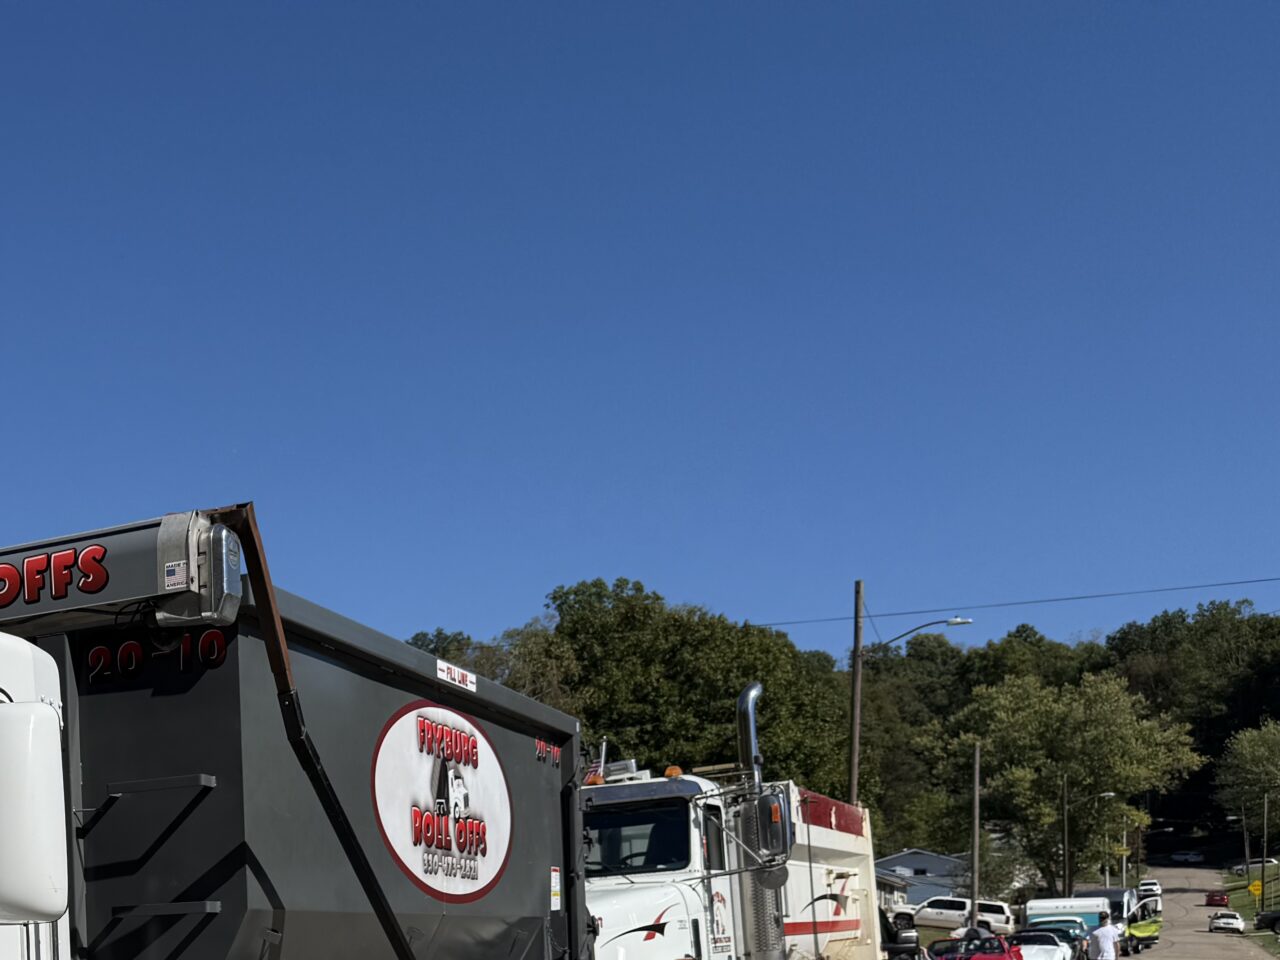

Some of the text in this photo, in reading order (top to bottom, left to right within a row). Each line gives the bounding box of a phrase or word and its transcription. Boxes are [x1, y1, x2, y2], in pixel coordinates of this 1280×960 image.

[446, 665, 457, 683] FILL
[417, 715, 479, 770] FRYBURG
[411, 805, 487, 858] ROLL OFFS
